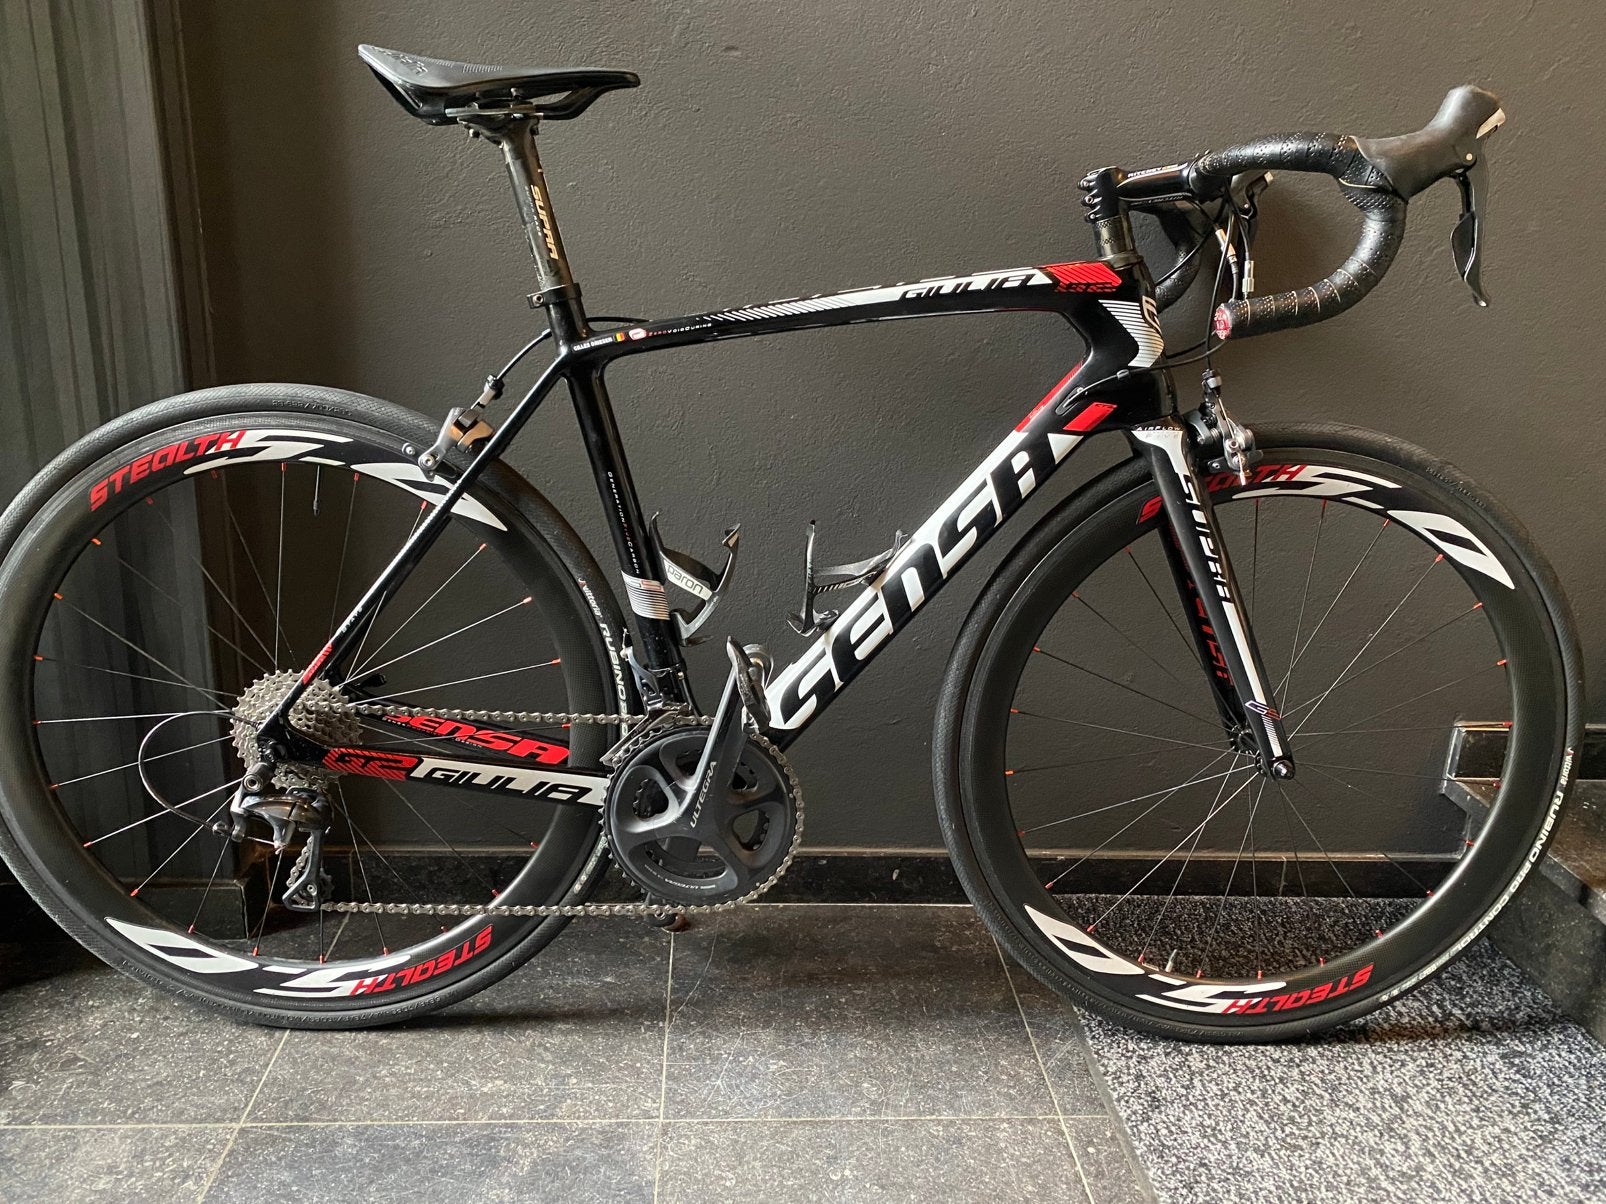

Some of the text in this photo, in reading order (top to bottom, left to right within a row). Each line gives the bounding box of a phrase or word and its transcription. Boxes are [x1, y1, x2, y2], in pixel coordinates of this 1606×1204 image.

[531, 184, 559, 260] SUPRA
[899, 272, 1036, 300] GIULIA
[89, 429, 247, 511] STEALTH
[665, 563, 705, 595] paron
[775, 430, 1068, 728] SENSA
[582, 585, 603, 618] vittoria
[600, 623, 627, 701] RUBINO
[422, 766, 593, 805] GIULIA
[690, 761, 717, 829] ULTEGRA
[1449, 754, 1573, 958] vittoria RUBINO PRO CONTROL
[351, 924, 493, 996] STEALTH
[1221, 964, 1374, 1015] STEALTH
